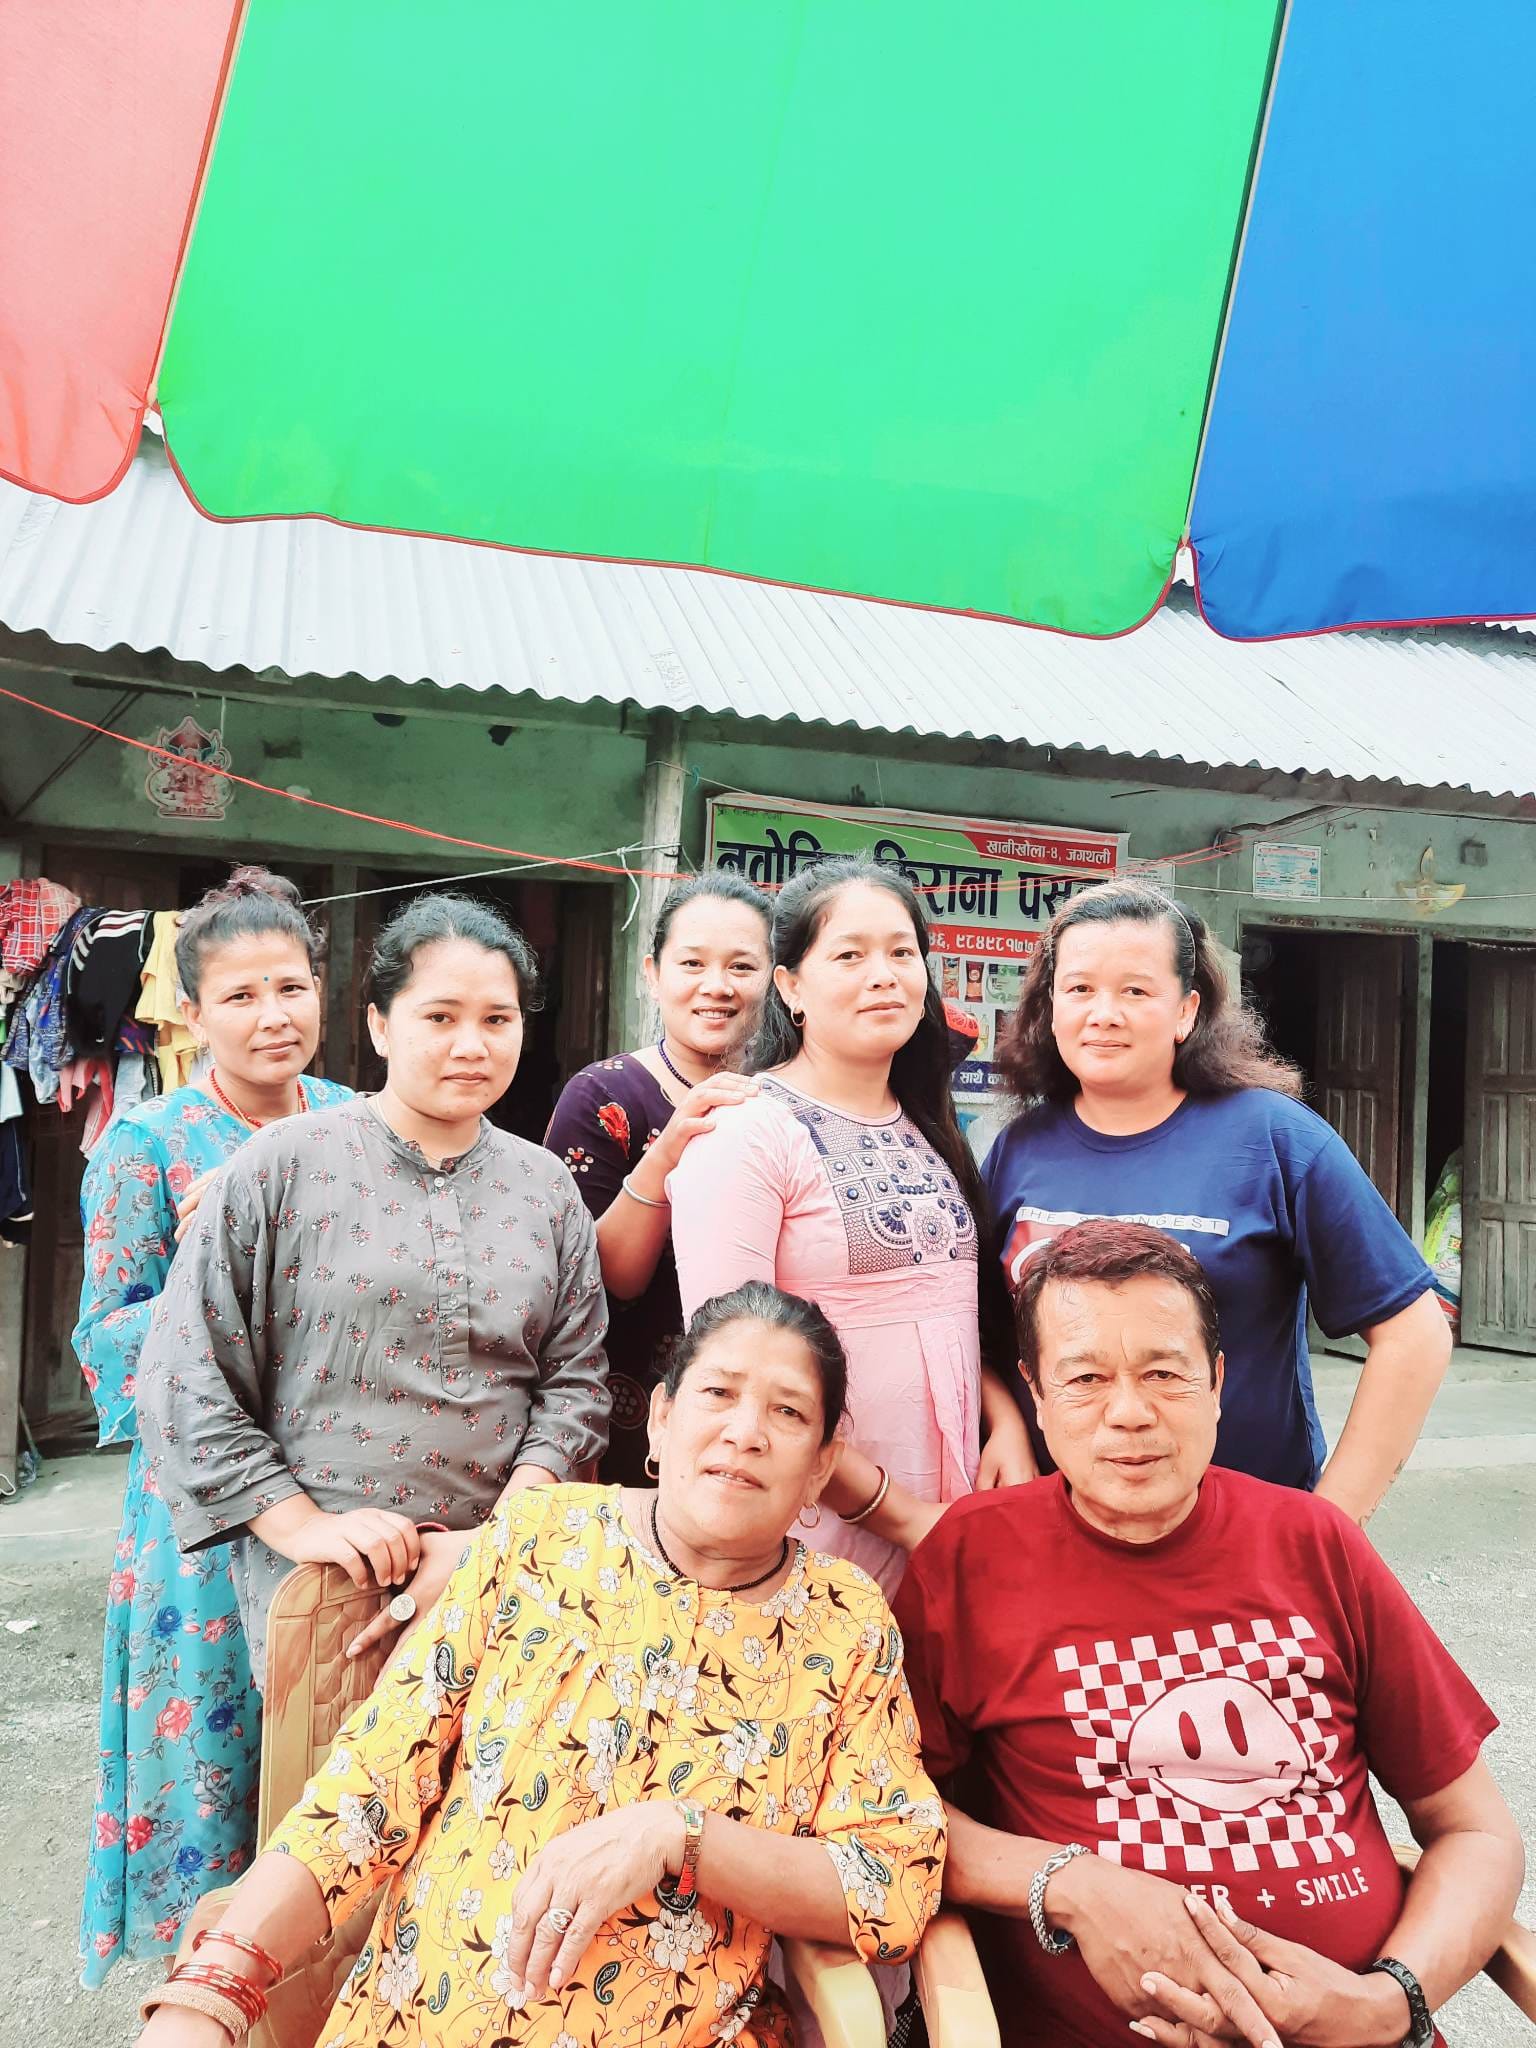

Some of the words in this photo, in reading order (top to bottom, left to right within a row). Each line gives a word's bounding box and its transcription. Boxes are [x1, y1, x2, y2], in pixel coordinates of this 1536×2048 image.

[1065, 847, 1111, 864] जगथली
[1018, 871, 1109, 920] पस
[1020, 1208, 1057, 1223] THE
[1295, 1866, 1369, 1906] SMILE
